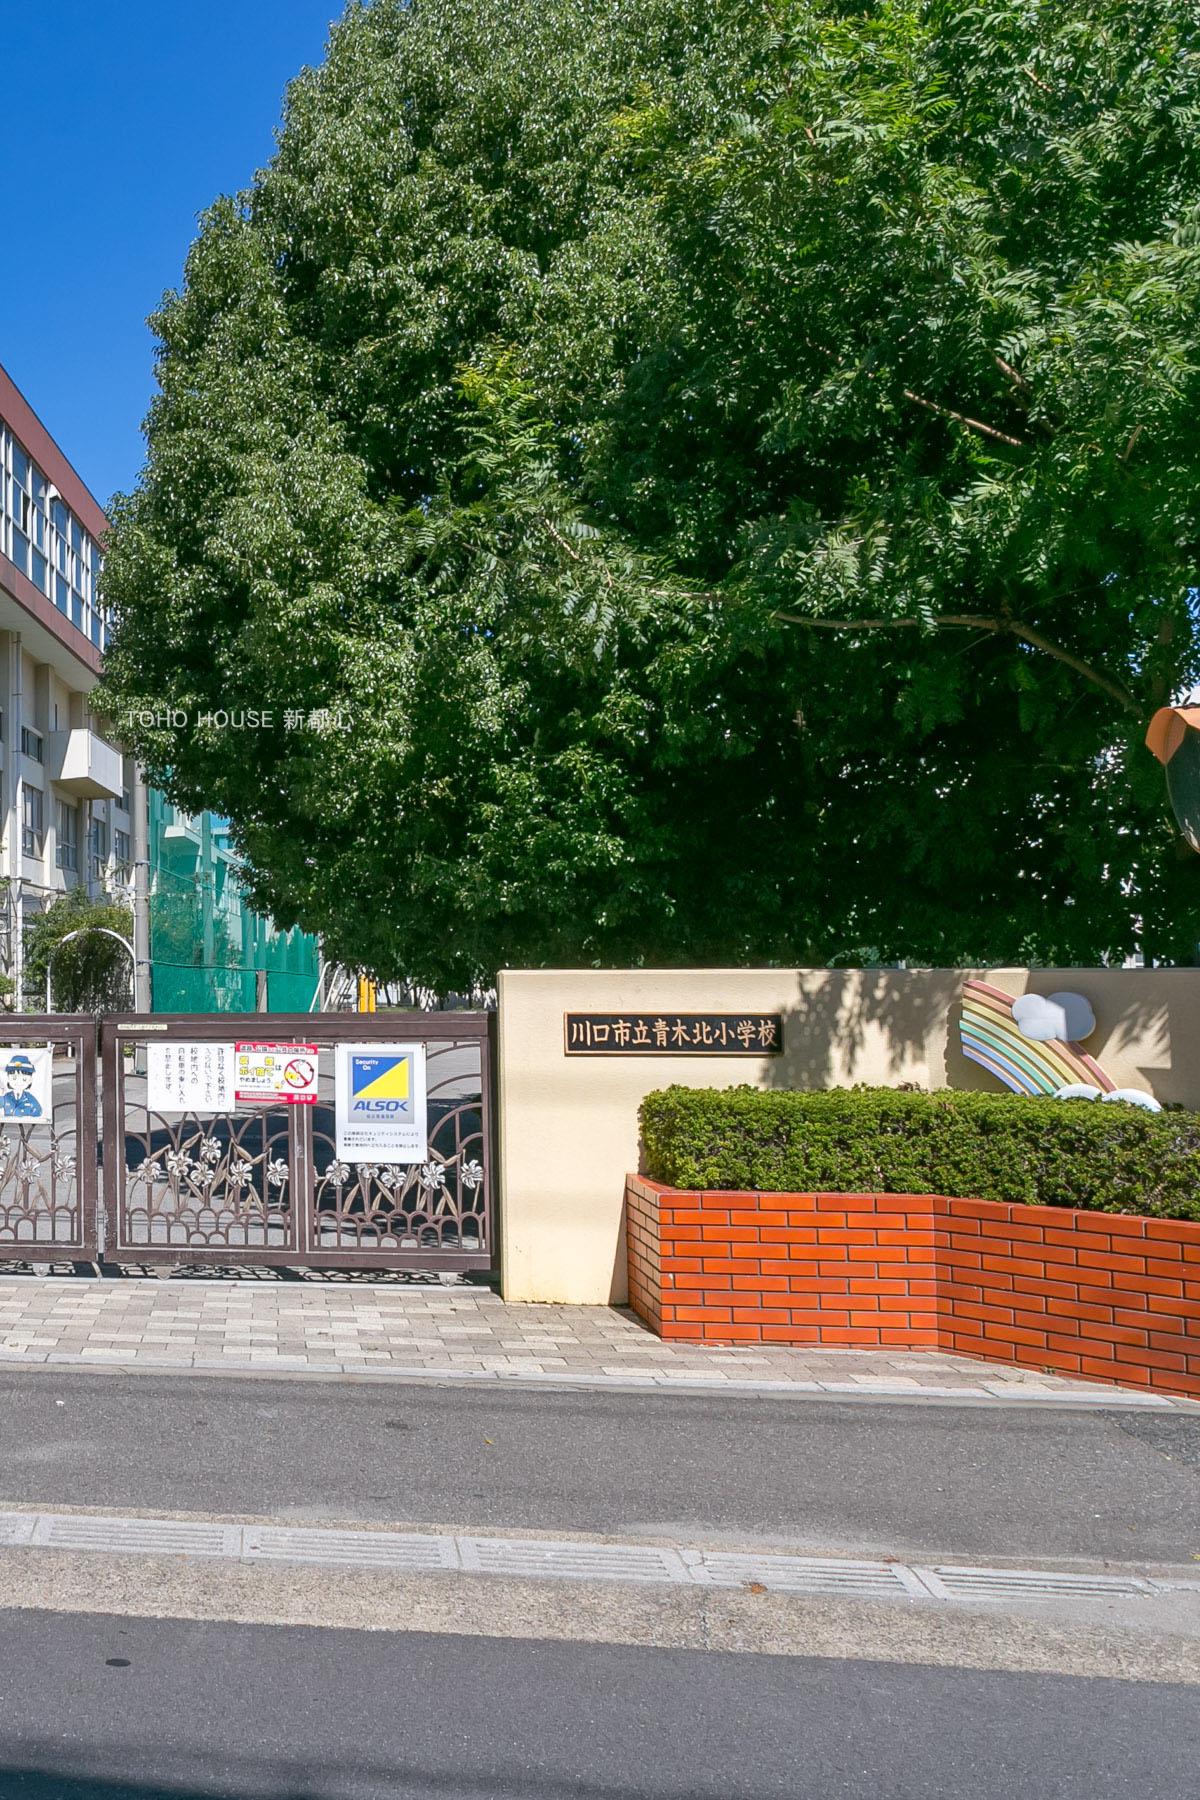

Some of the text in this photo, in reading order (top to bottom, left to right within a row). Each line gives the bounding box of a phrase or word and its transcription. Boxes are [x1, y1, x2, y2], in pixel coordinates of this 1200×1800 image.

[571, 1018, 778, 1048] 川口市立青木北小学校
[355, 1058, 379, 1066] Security
[353, 1100, 409, 1112] ALSOK
